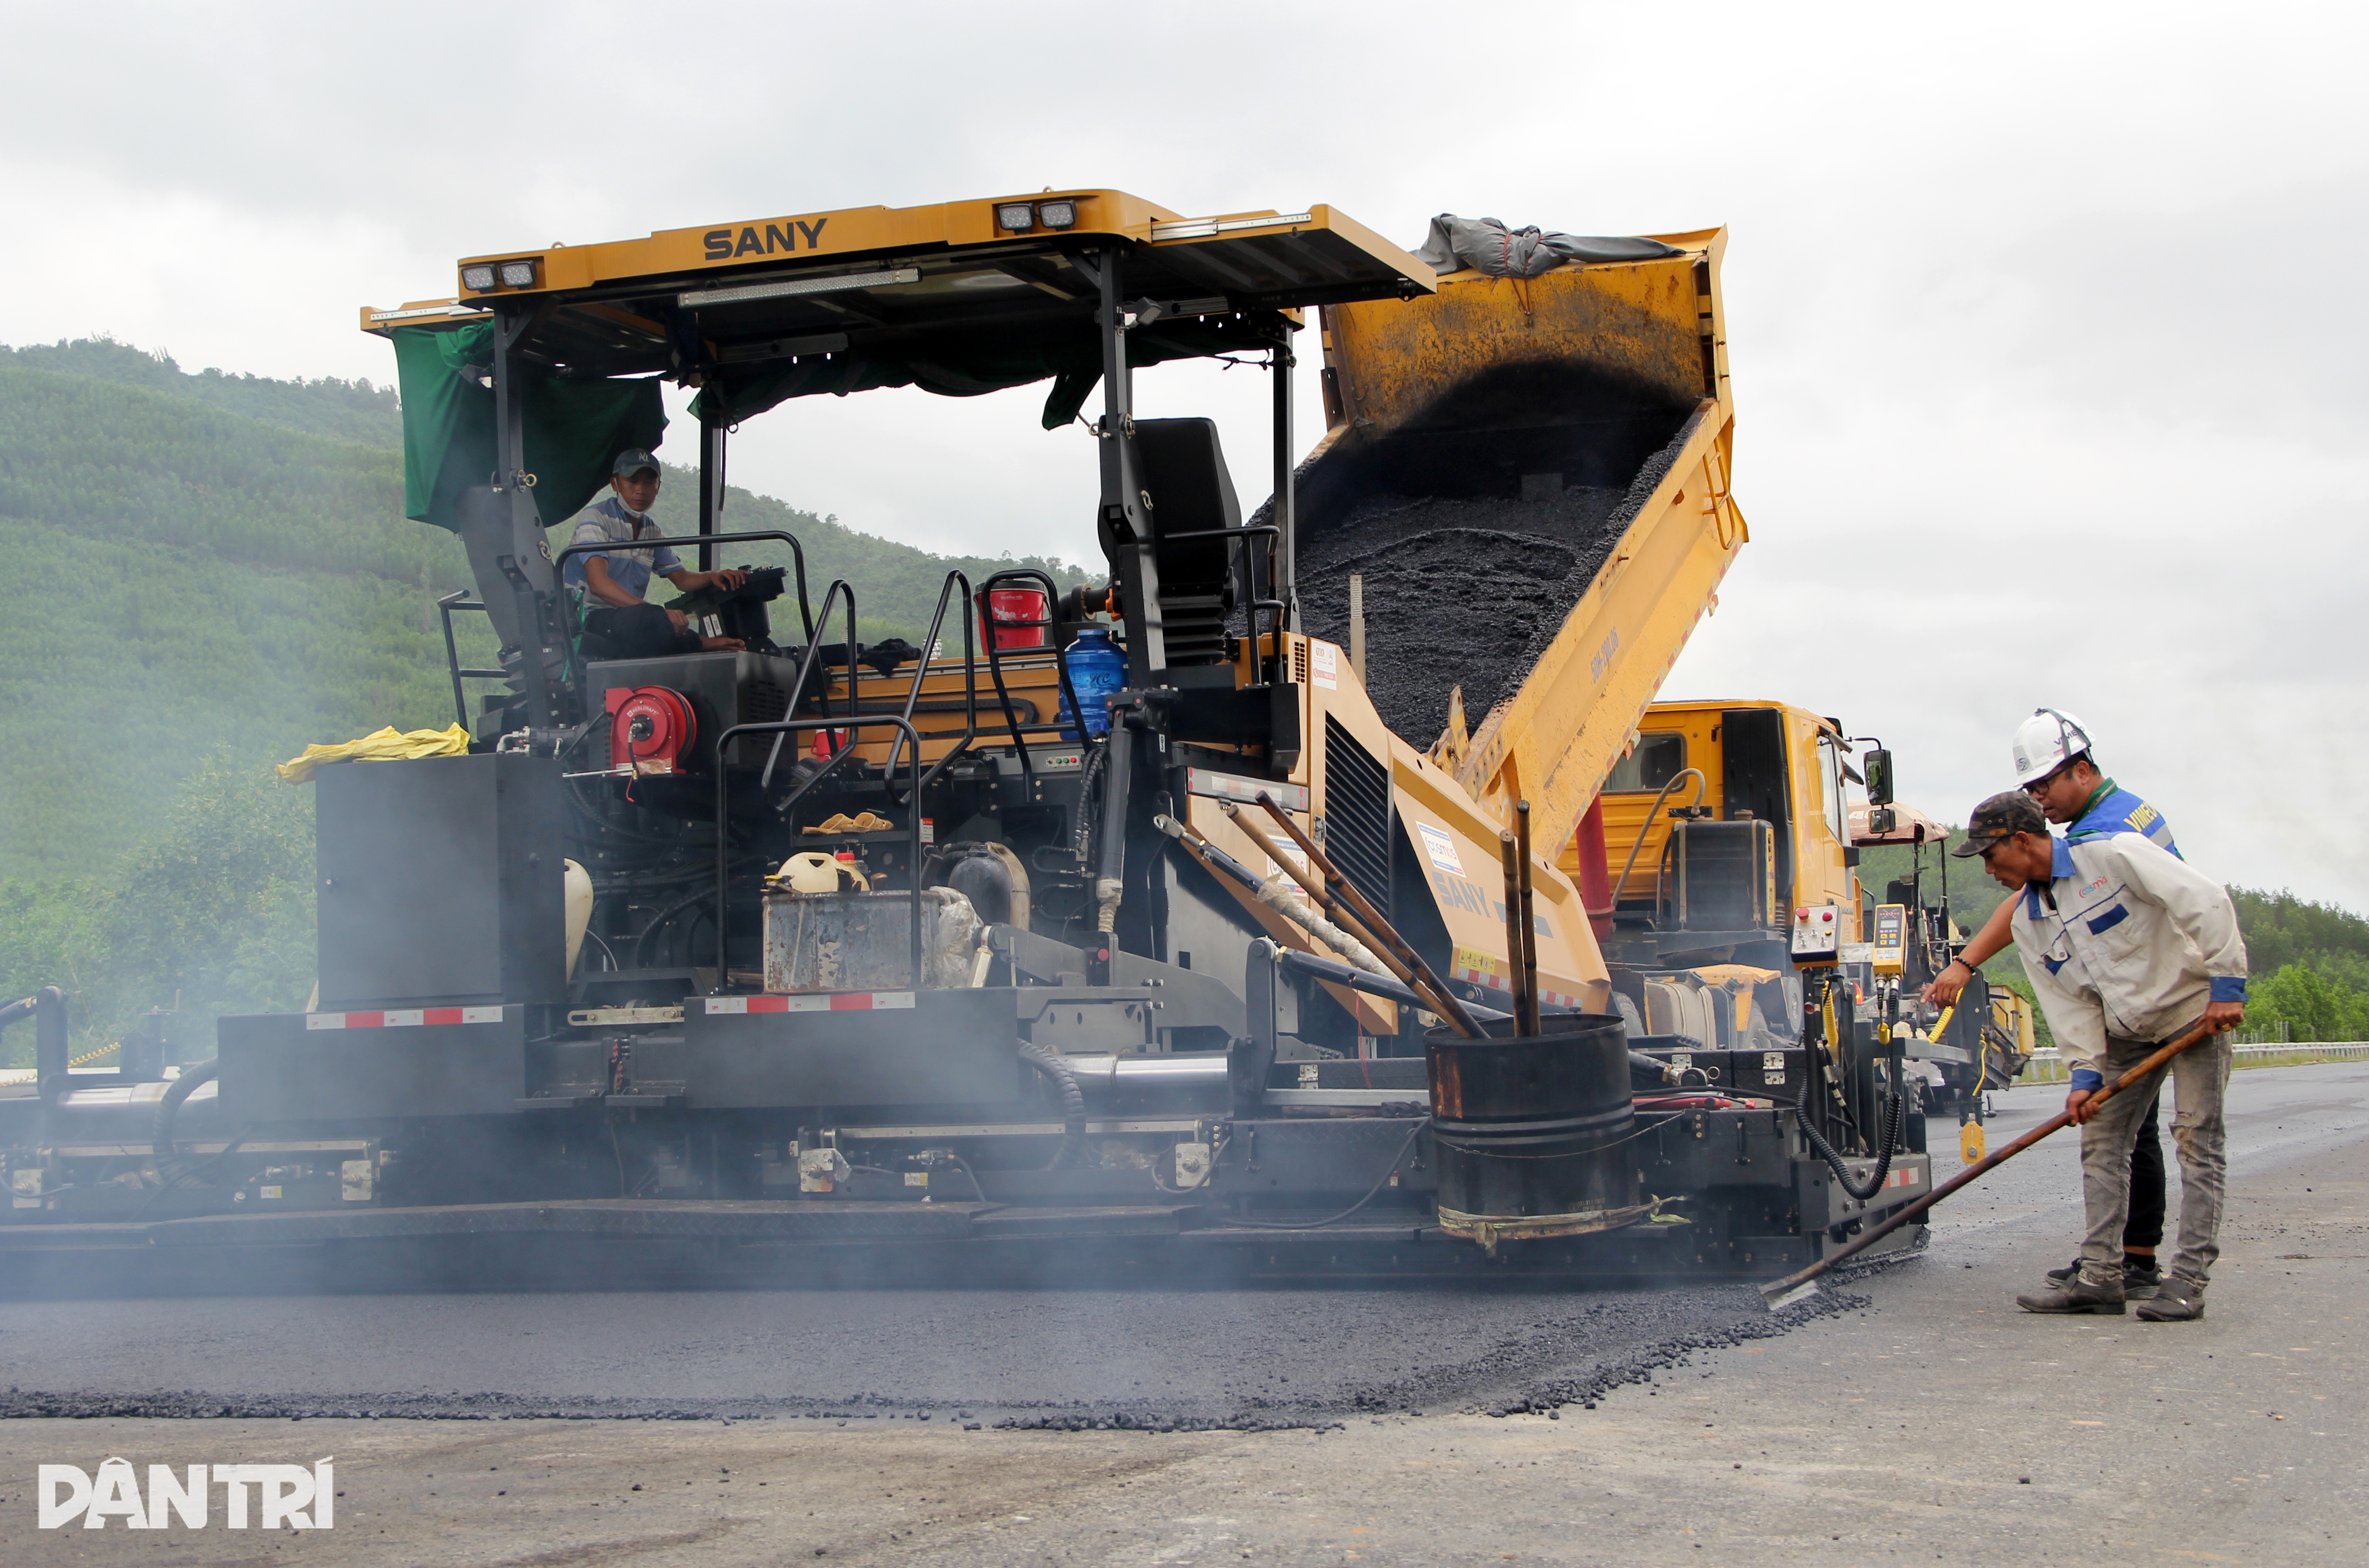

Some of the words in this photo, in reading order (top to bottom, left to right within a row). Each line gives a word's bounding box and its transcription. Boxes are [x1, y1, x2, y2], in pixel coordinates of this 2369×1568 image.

[704, 218, 827, 260] SANY
[632, 706, 657, 716] REELCRAFT
[1432, 871, 1491, 918] SANY
